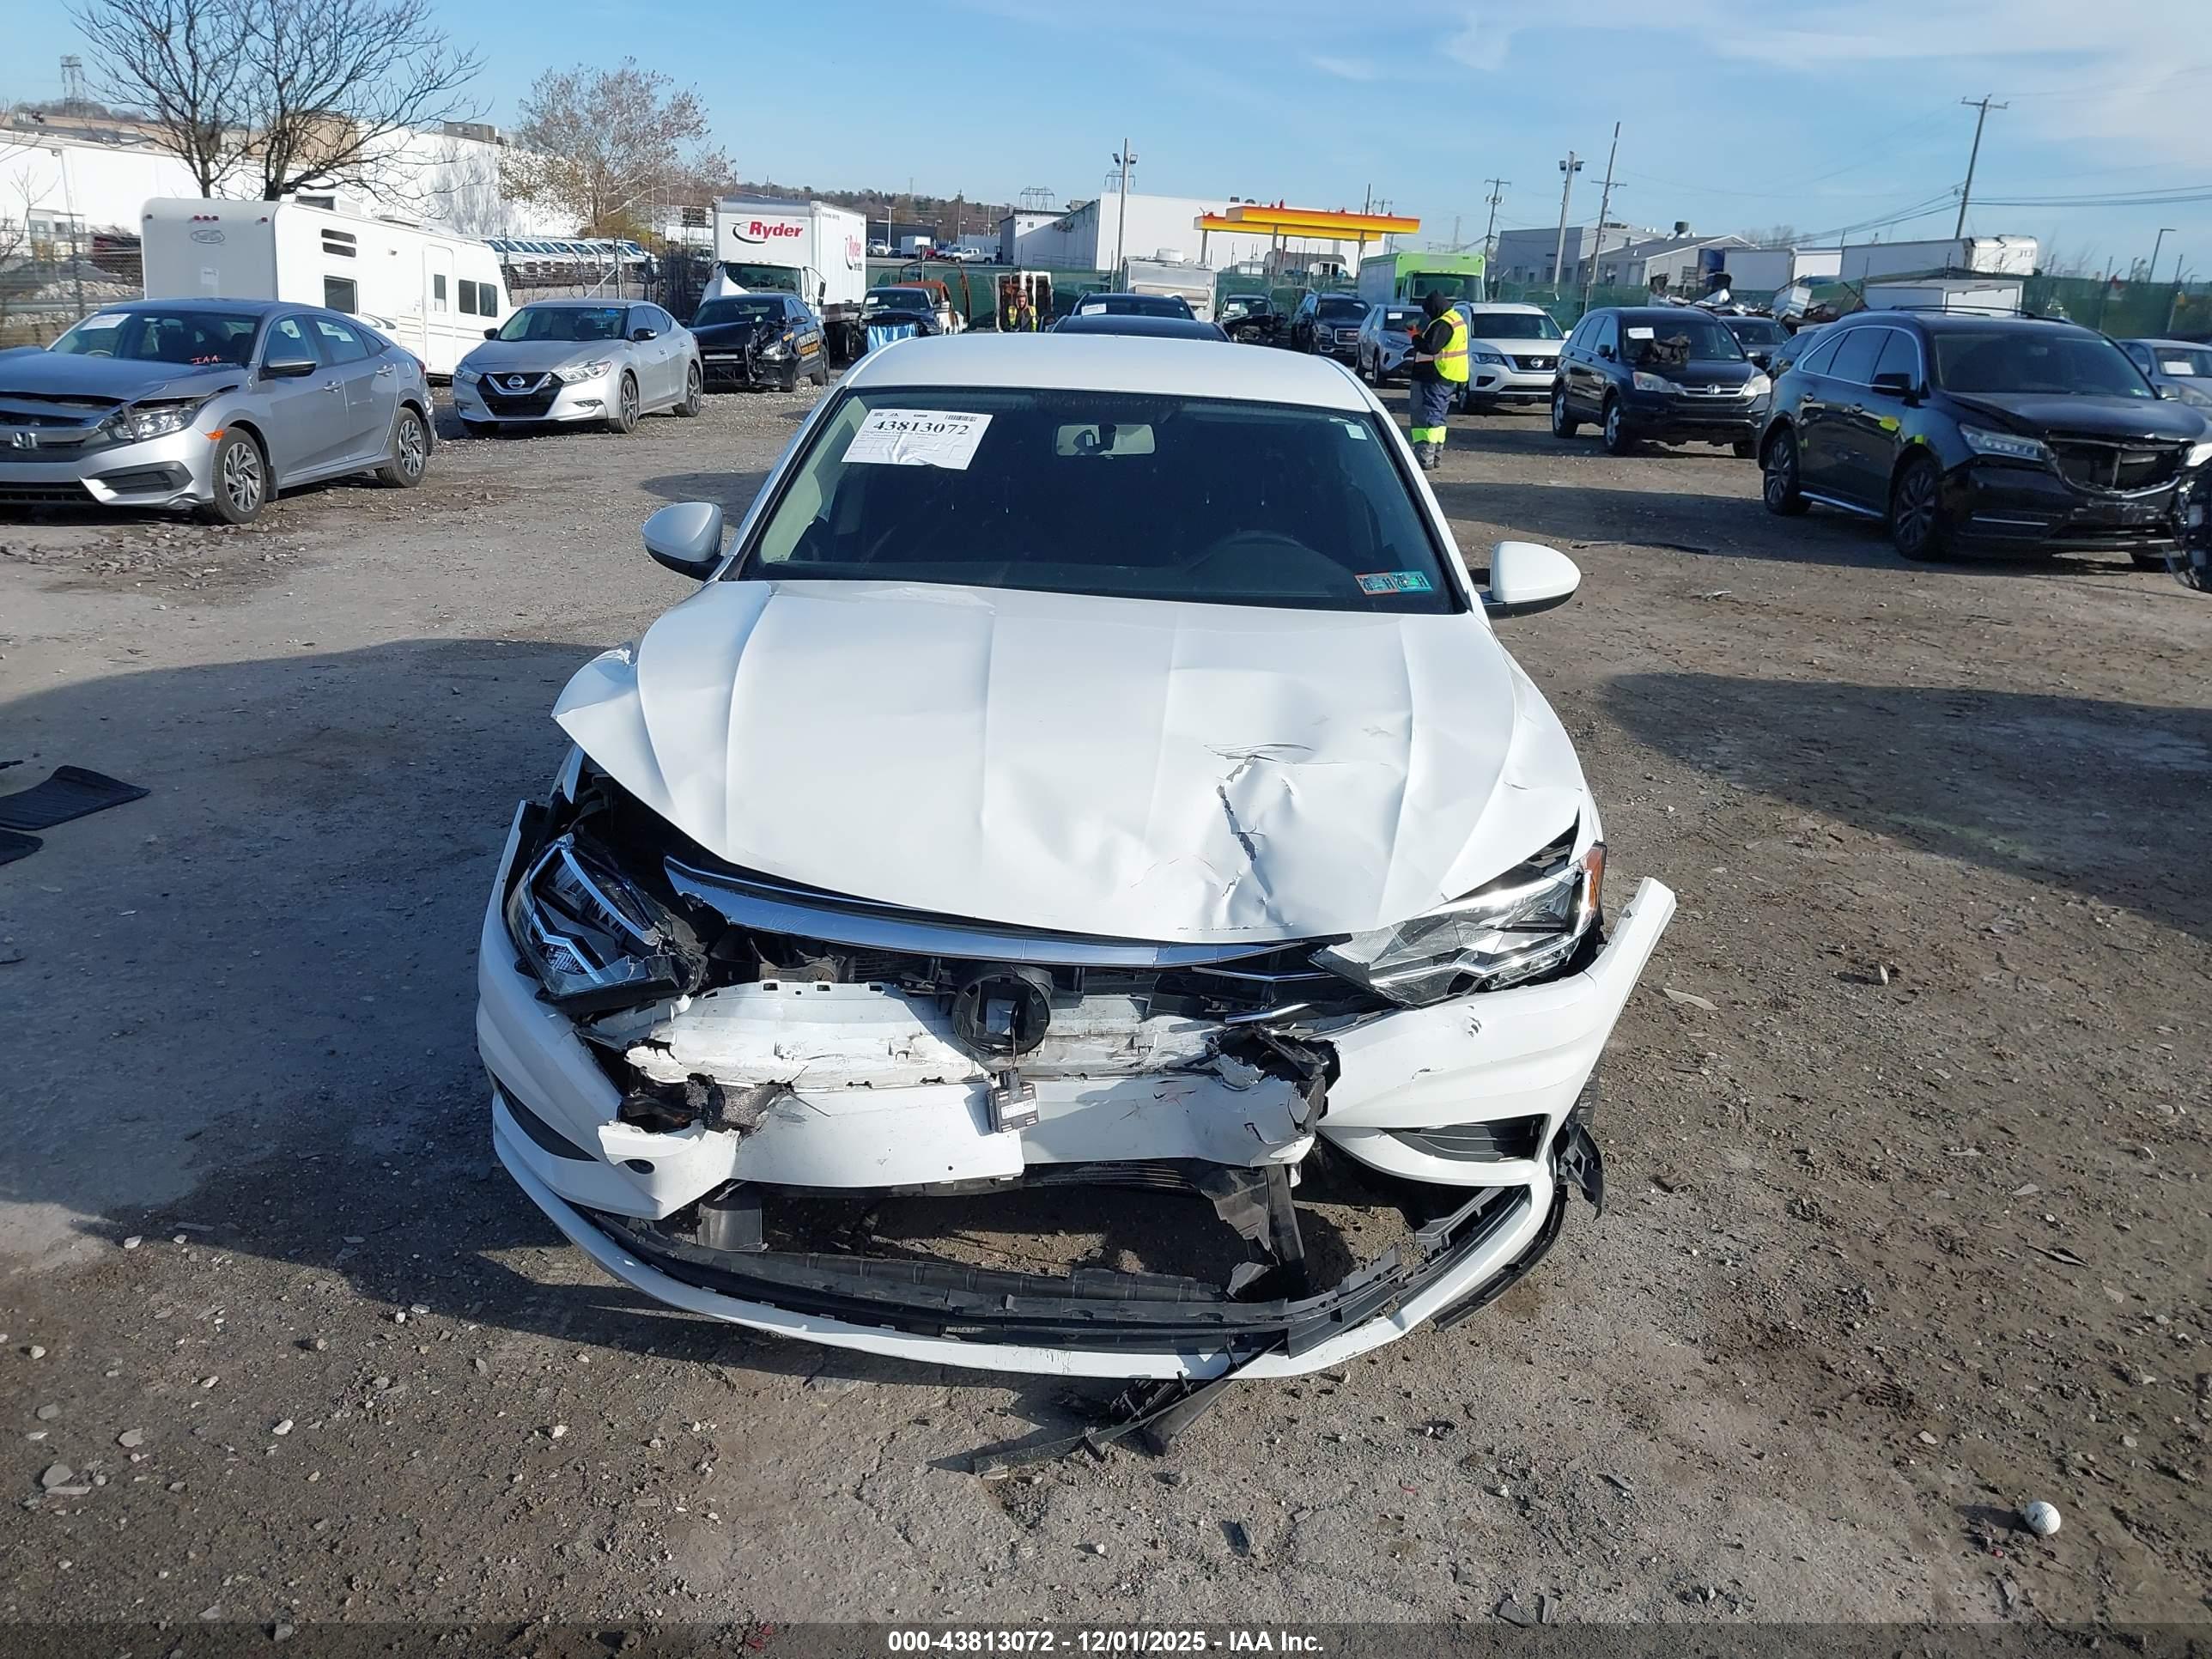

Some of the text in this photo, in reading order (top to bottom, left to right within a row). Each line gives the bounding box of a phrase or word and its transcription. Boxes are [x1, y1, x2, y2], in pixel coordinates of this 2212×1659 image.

[749, 221, 804, 240] Ryder
[191, 355, 220, 365] IAA
[872, 420, 969, 435] 43813072
